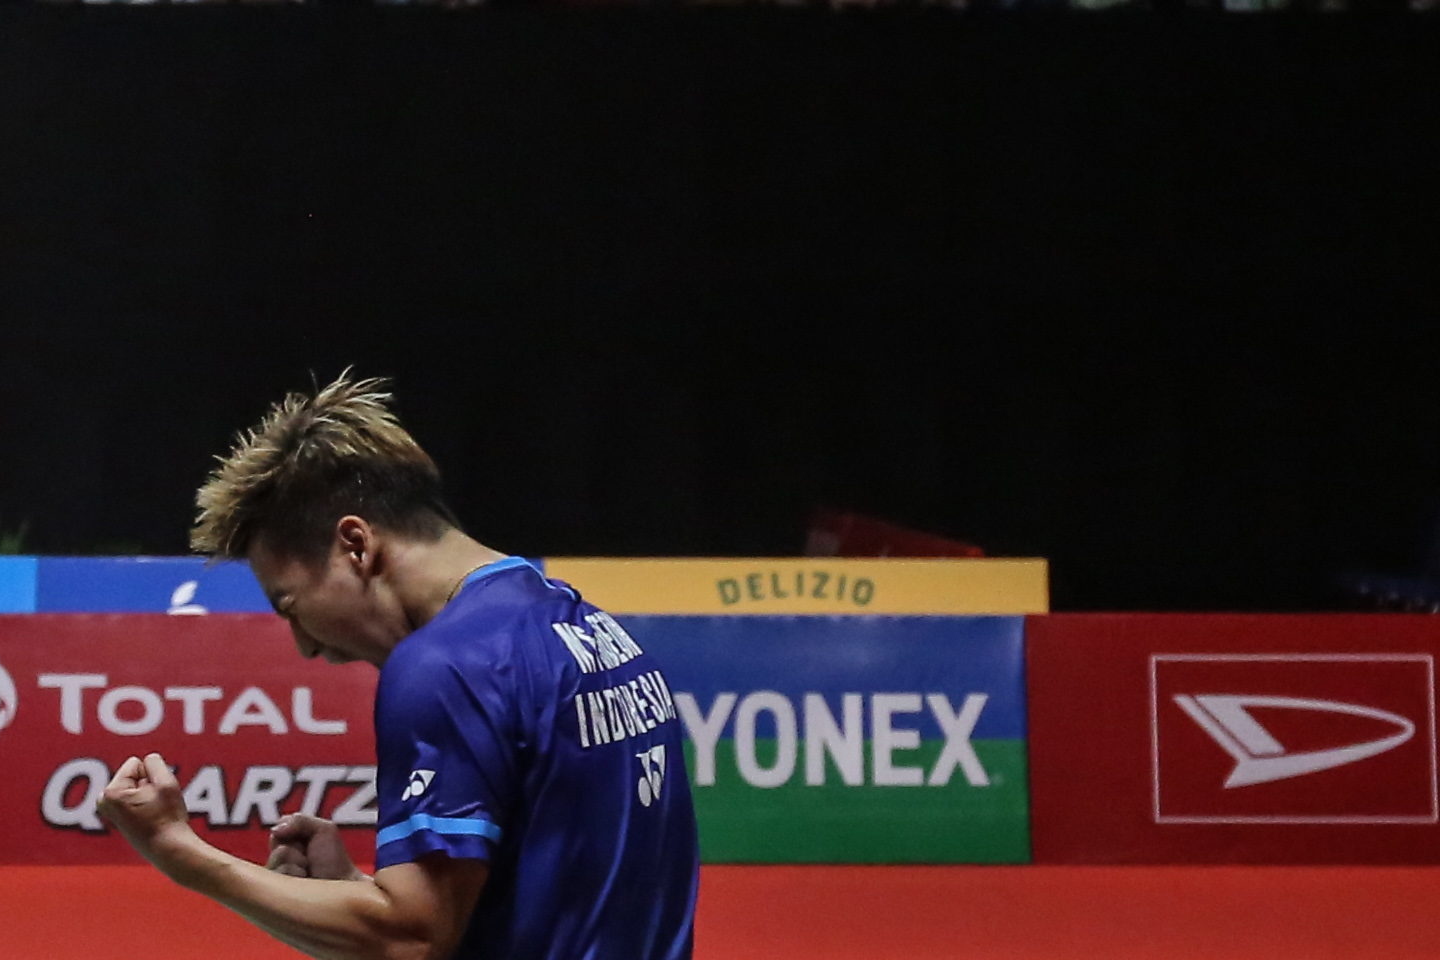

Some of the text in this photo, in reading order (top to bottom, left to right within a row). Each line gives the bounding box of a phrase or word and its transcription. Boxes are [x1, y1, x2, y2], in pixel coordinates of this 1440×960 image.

[717, 571, 876, 606] DELIZIO
[574, 670, 677, 748] INDONESIA
[672, 690, 991, 789] YONEX
[40, 757, 379, 832] QARTZ
